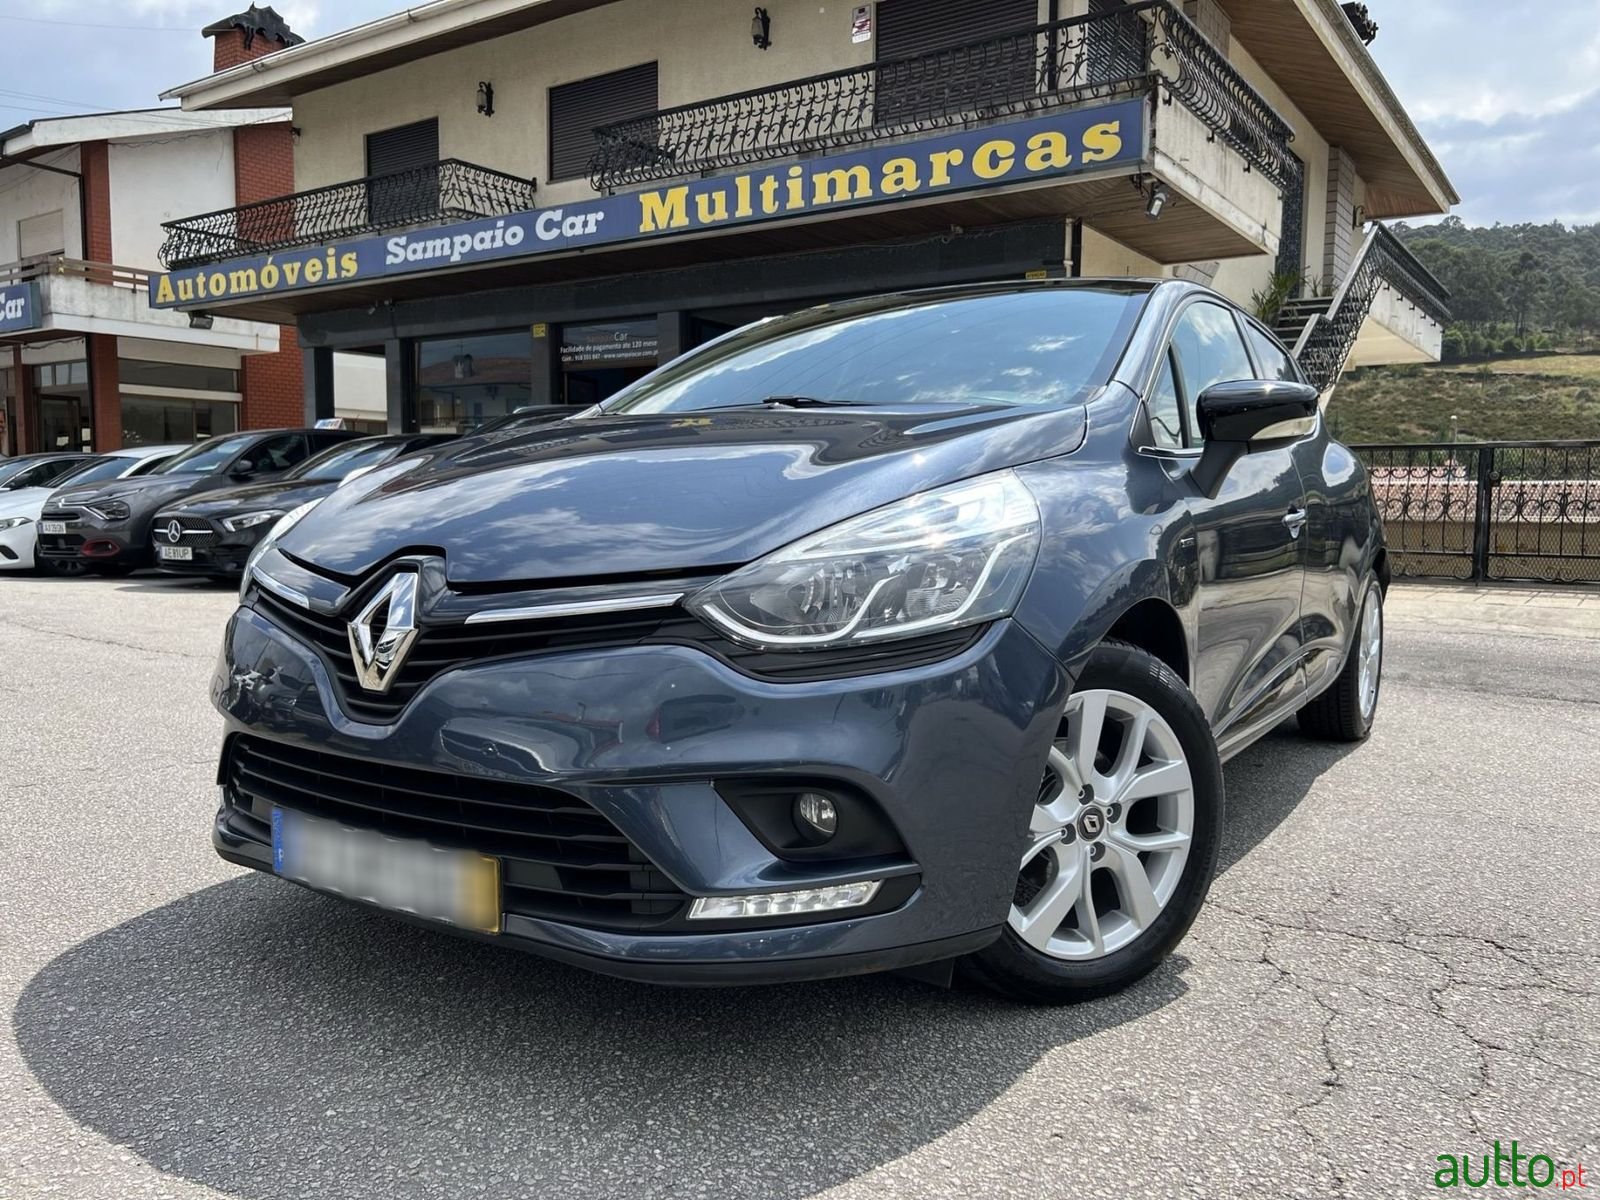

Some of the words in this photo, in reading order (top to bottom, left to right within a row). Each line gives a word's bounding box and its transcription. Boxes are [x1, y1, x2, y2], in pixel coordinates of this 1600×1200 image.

[155, 247, 359, 304] Automóveis
[385, 220, 525, 265] Sampaio
[535, 209, 605, 241] Car
[638, 120, 1124, 234] Multimarcas
[614, 331, 628, 342] Car
[560, 345, 584, 354] Facilidade
[585, 344, 592, 352] de
[592, 343, 621, 352] pagamento
